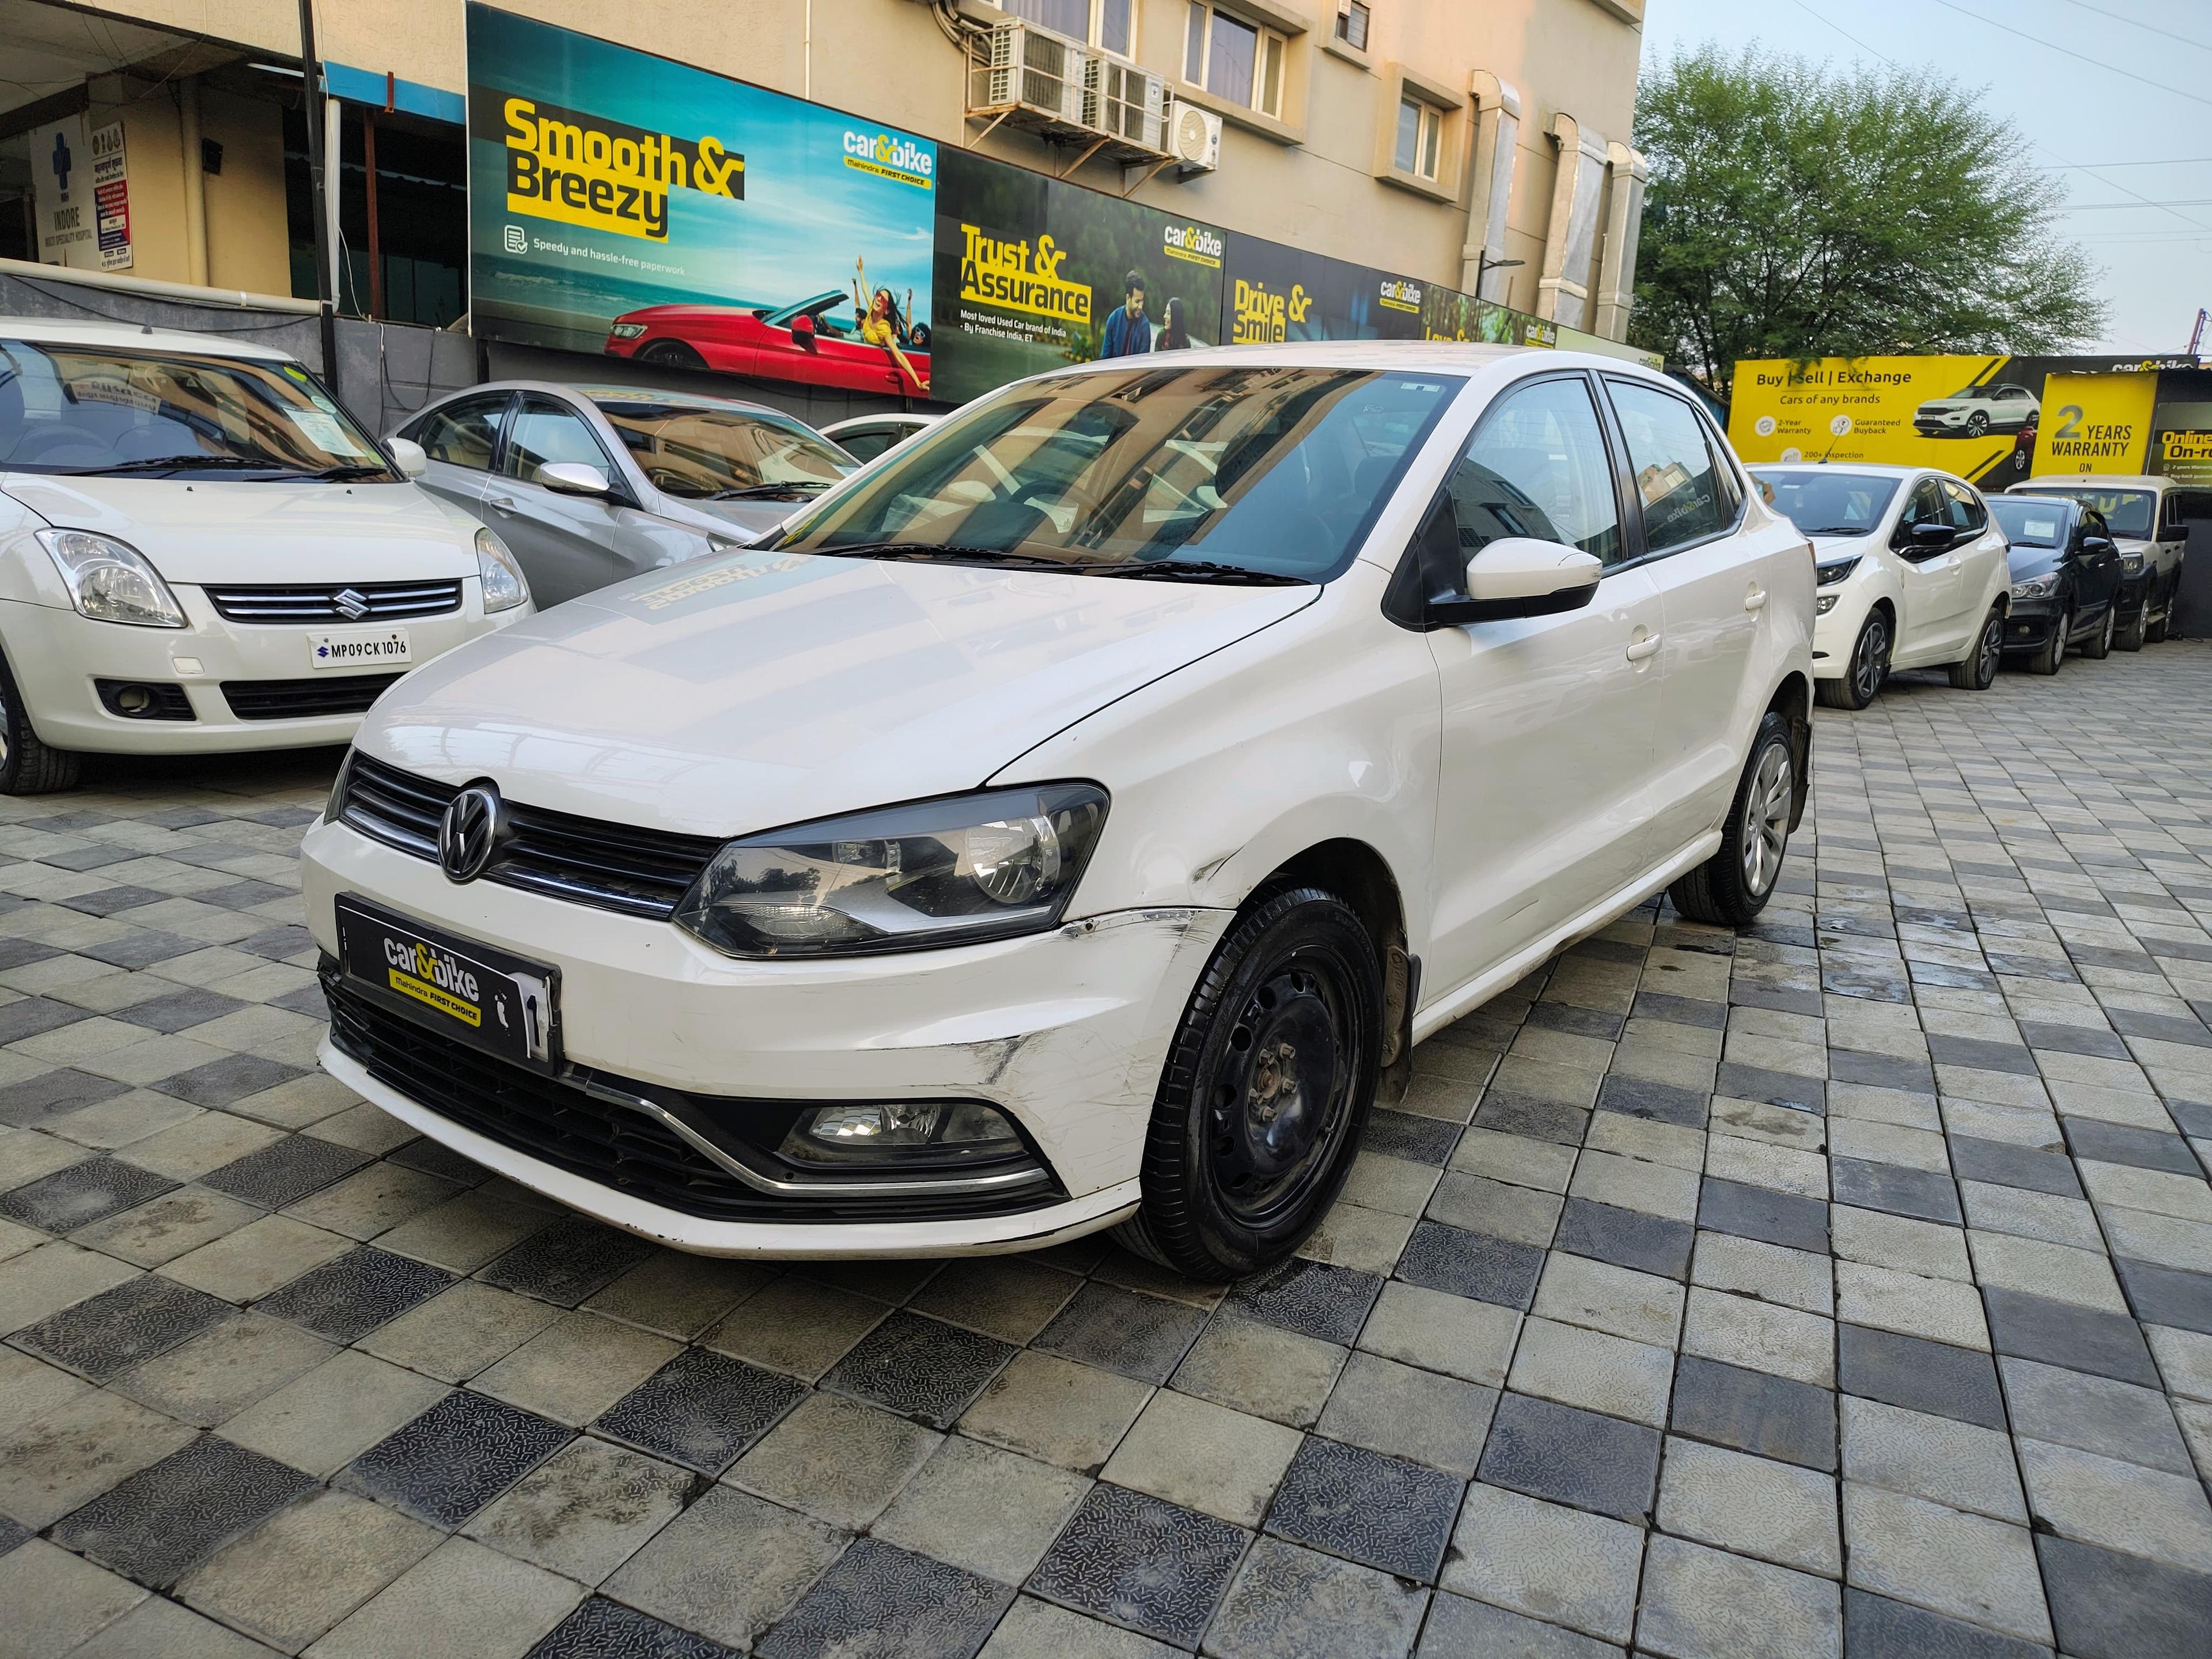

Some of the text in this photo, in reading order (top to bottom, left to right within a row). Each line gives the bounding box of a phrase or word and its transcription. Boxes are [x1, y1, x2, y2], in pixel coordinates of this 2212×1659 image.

[505, 97, 745, 199] Smooth &
[843, 131, 932, 175] car&bike
[881, 169, 901, 179] FIRST
[902, 175, 925, 185] CHOICE
[507, 148, 668, 238] Breezy
[54, 206, 80, 231] INDORE
[961, 223, 1067, 281] Trust &
[1164, 226, 1222, 257] car&bike
[533, 238, 685, 276] Speedy and hassle-free paperwork
[961, 260, 1089, 317] Assurance
[1234, 279, 1313, 323] Drive &
[1380, 281, 1421, 304] car&bike
[960, 309, 1066, 338] Most loved Used Car brand of India
[964, 322, 974, 334] By
[975, 325, 1005, 338] Franchise
[1006, 330, 1024, 342] India,
[1025, 334, 1033, 343] ET
[1233, 309, 1283, 343] Smile
[1757, 374, 1783, 387] Buy
[1838, 371, 1911, 385] Exchange
[1780, 393, 1880, 406] Cars of any brands
[1854, 427, 1887, 435] Buyback
[2054, 404, 2133, 440] 2 YEARS
[2051, 441, 2129, 456] WARRANTY
[2162, 430, 2212, 444] Online
[2079, 463, 2092, 472] ON
[384, 937, 479, 1002] car&bike
[430, 992, 450, 1007] FIRST
[451, 1002, 478, 1021] CHOICE
